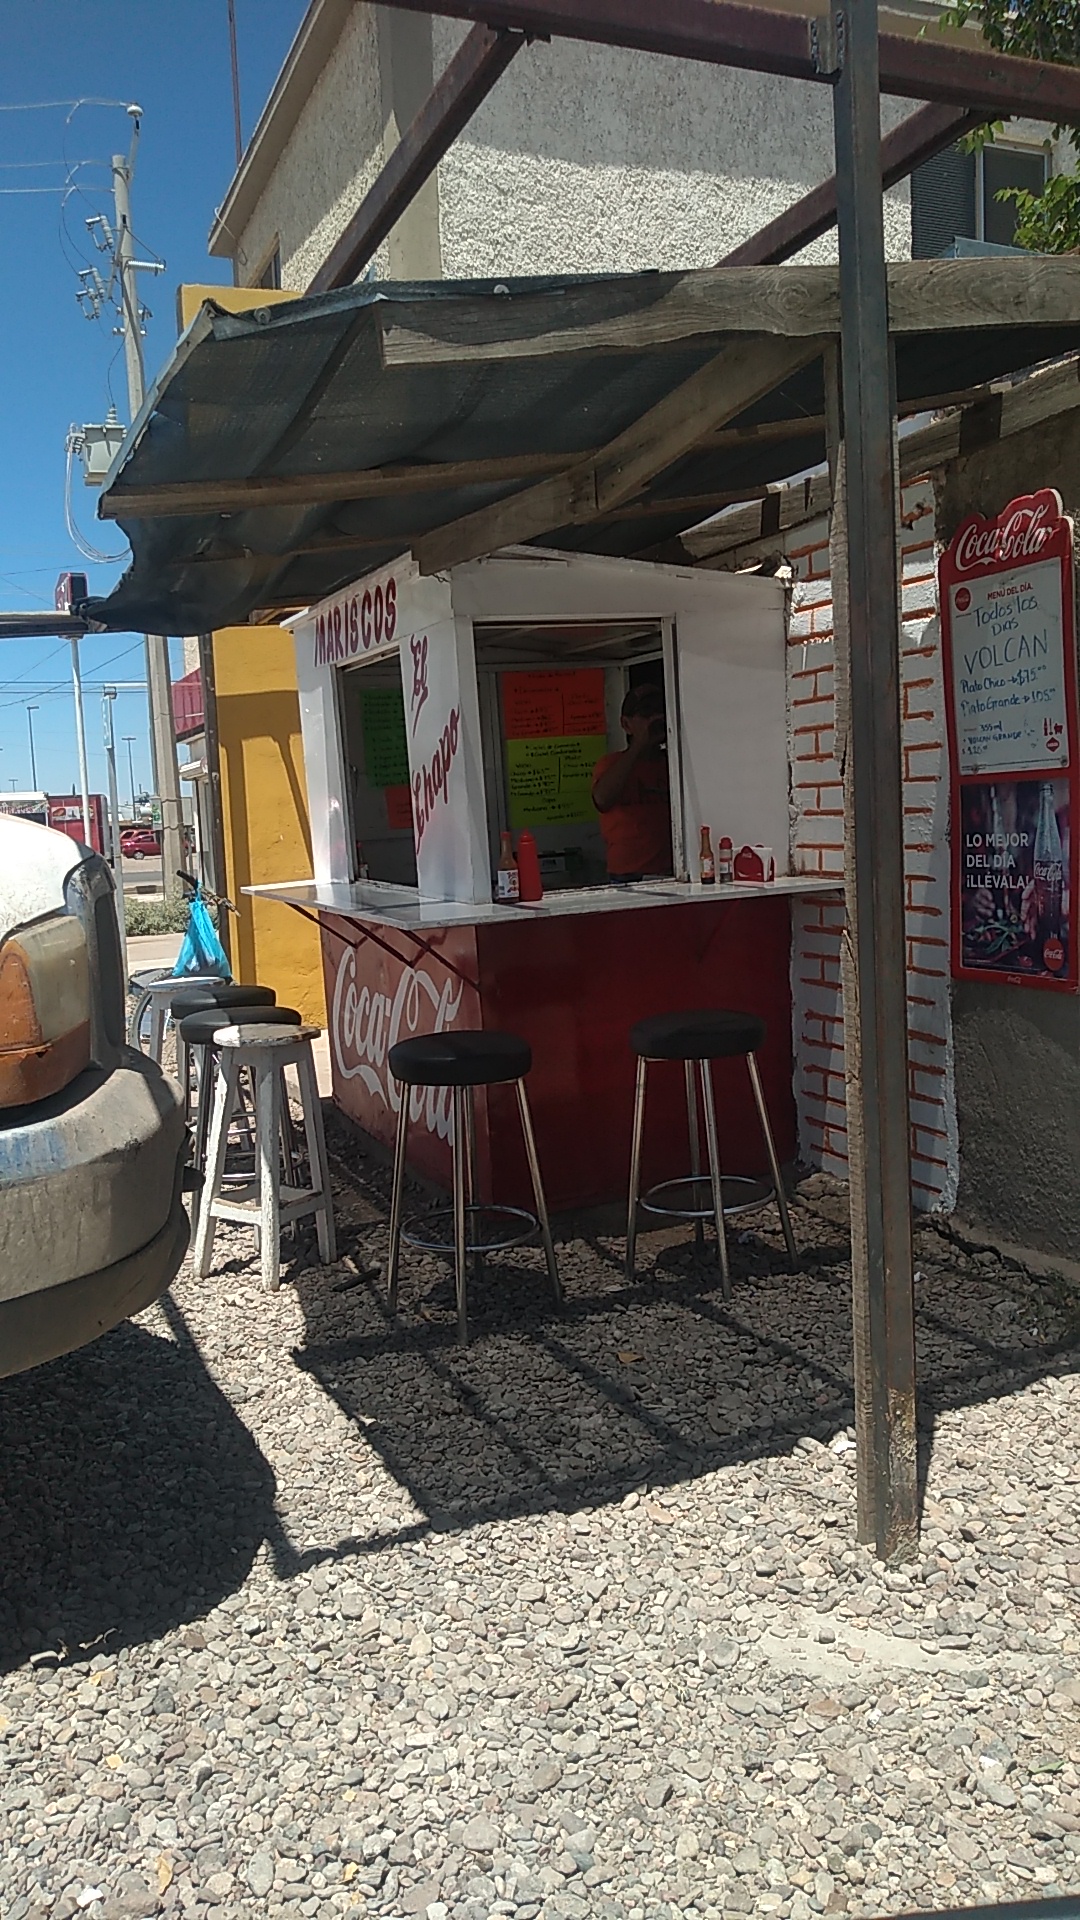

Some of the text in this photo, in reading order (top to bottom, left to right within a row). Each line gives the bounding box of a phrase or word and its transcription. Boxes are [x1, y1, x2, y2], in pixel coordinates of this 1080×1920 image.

[1006, 587, 1019, 596] DEL
[314, 577, 397, 667] MARISCOS
[973, 595, 1038, 627] Todos los
[964, 629, 1048, 675] VOLCAN
[411, 634, 428, 738] El
[986, 693, 1021, 711] Grande
[412, 702, 460, 856] Chapo
[966, 832, 1029, 847] LO MEJOR
[966, 854, 990, 868] DEL
